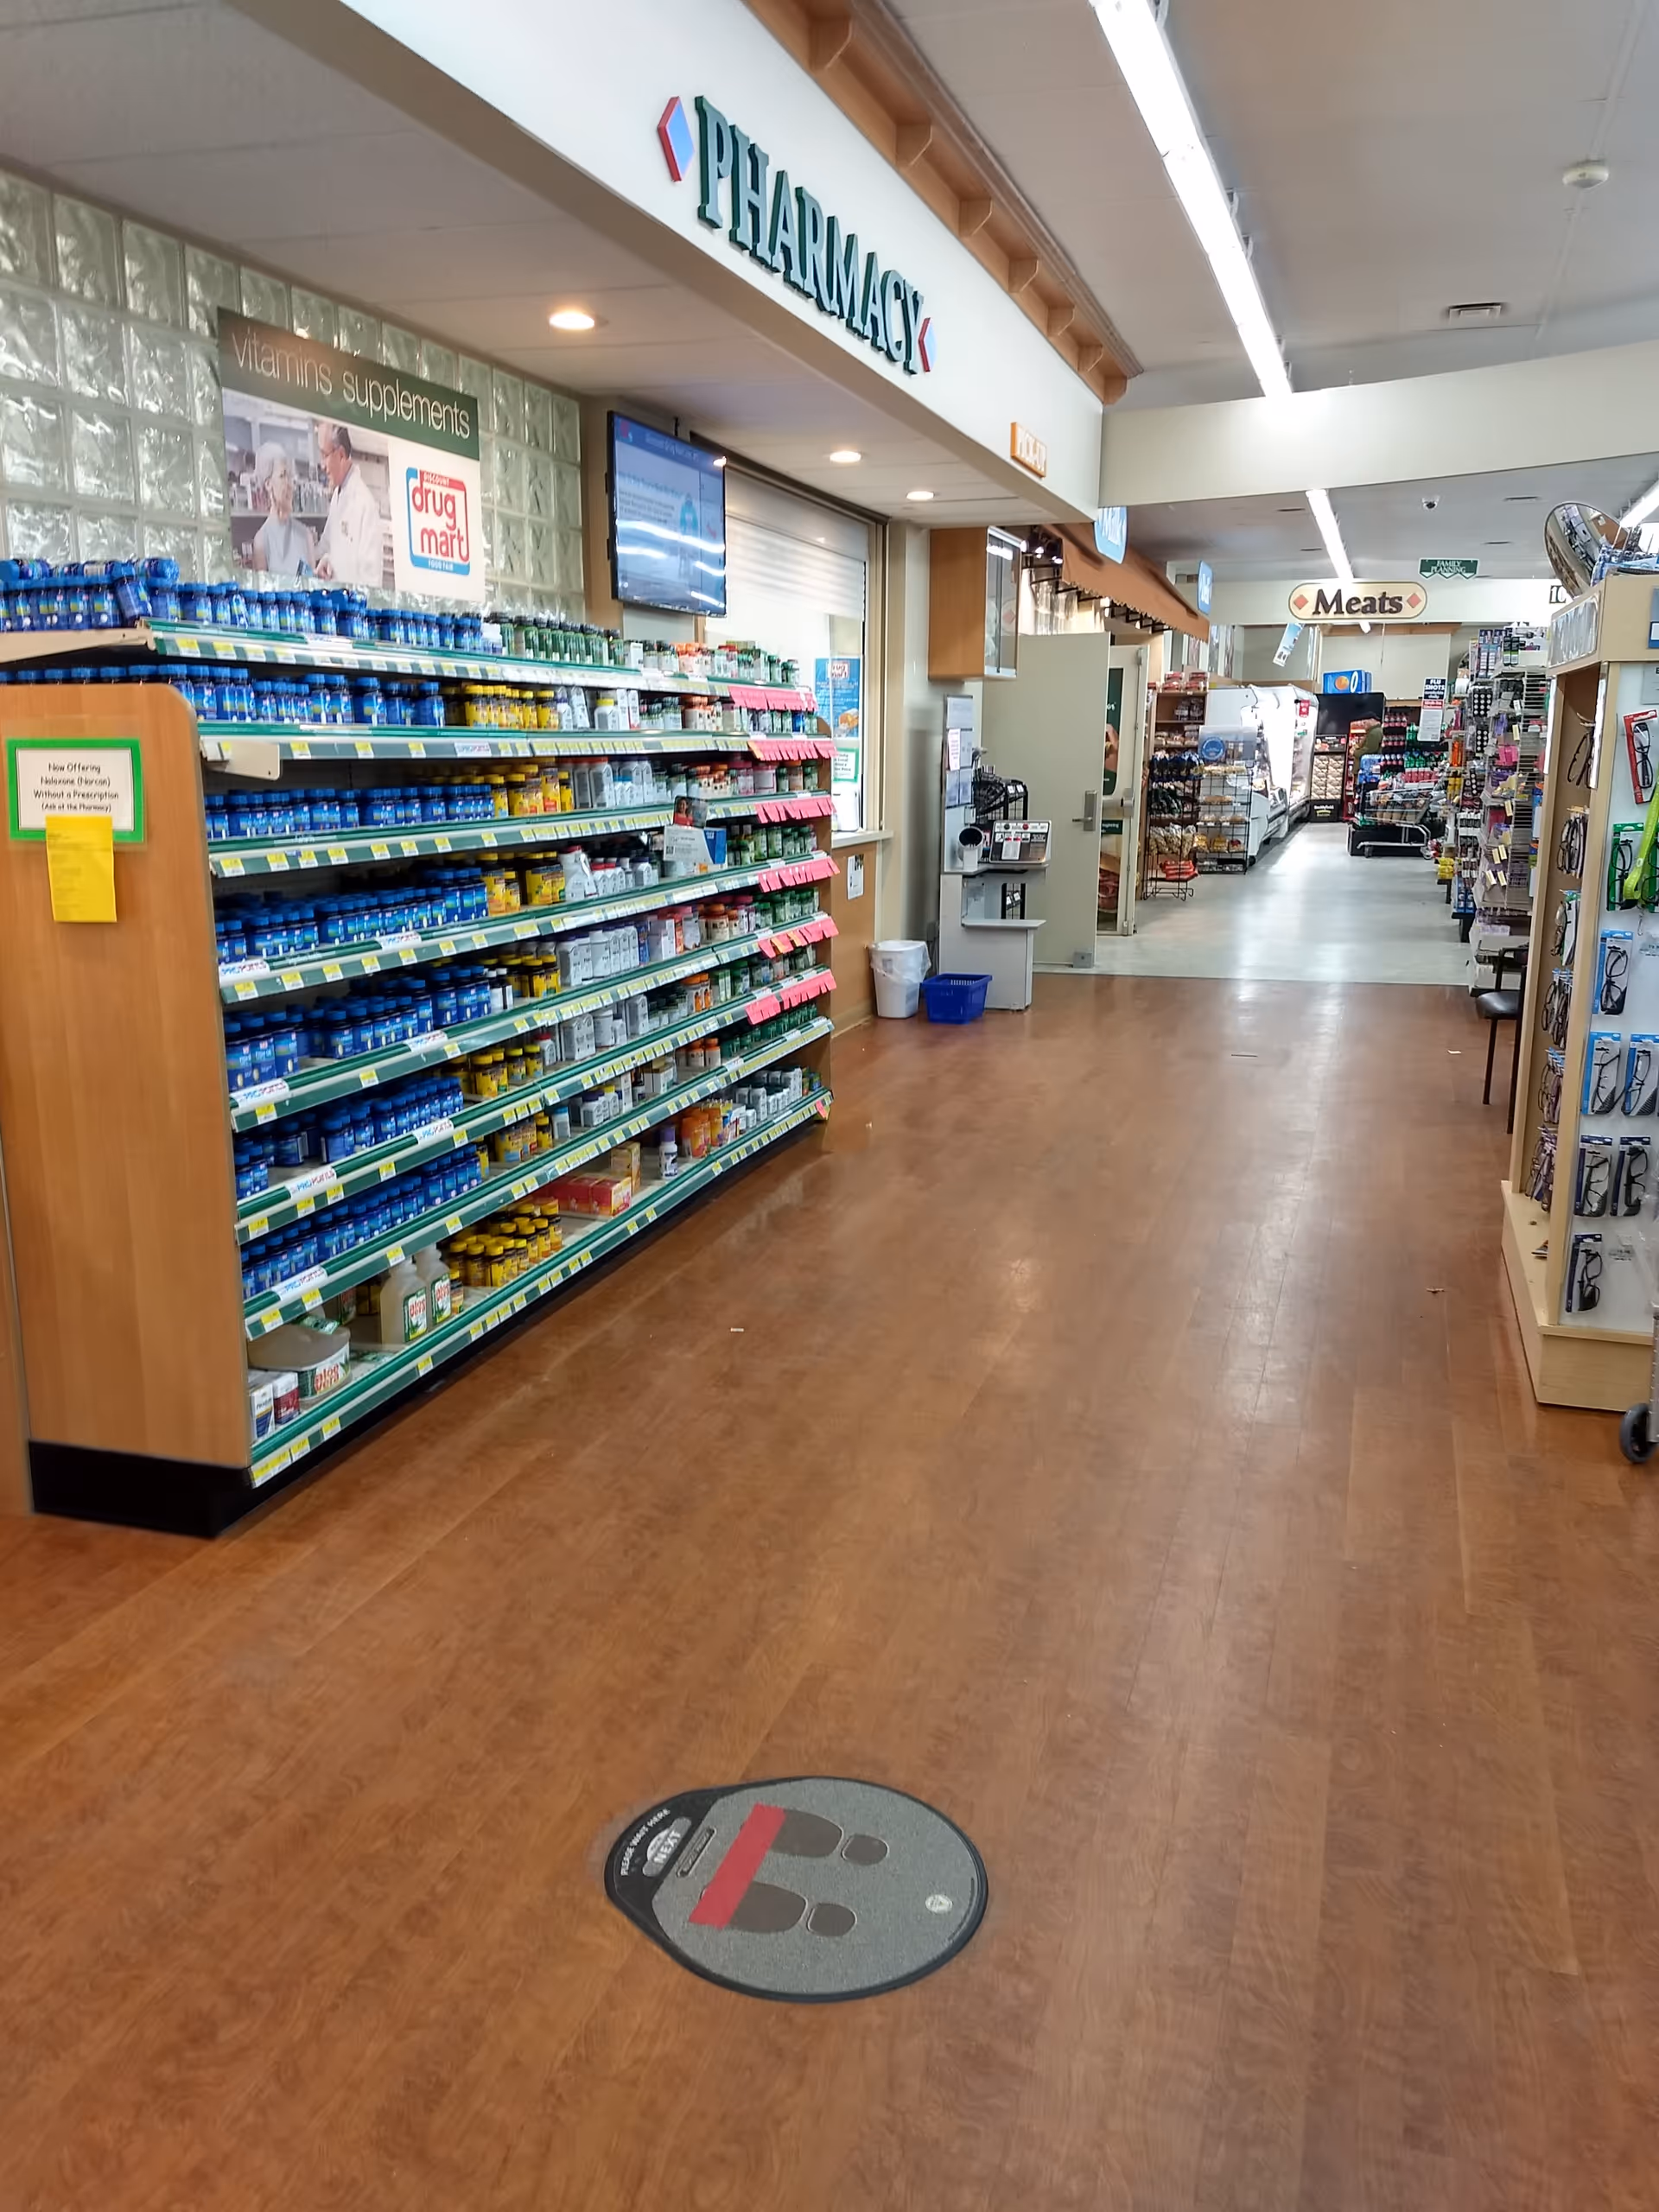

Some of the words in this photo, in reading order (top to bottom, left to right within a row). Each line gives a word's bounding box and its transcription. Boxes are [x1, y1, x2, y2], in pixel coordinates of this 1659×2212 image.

[694, 95, 925, 376] PHARMACY
[232, 328, 333, 395] vitamins
[342, 370, 470, 439] supplements
[423, 472, 449, 488] DISCOUNT
[412, 469, 456, 531] drug
[421, 527, 469, 563] mart
[1312, 588, 1403, 614] Meats
[48, 762, 65, 772] Now
[67, 762, 101, 775] Offering
[33, 789, 65, 799] Without
[73, 789, 119, 803] Prescription
[620, 1847, 635, 1876] PLEASE
[653, 1830, 681, 1864] NEXT
